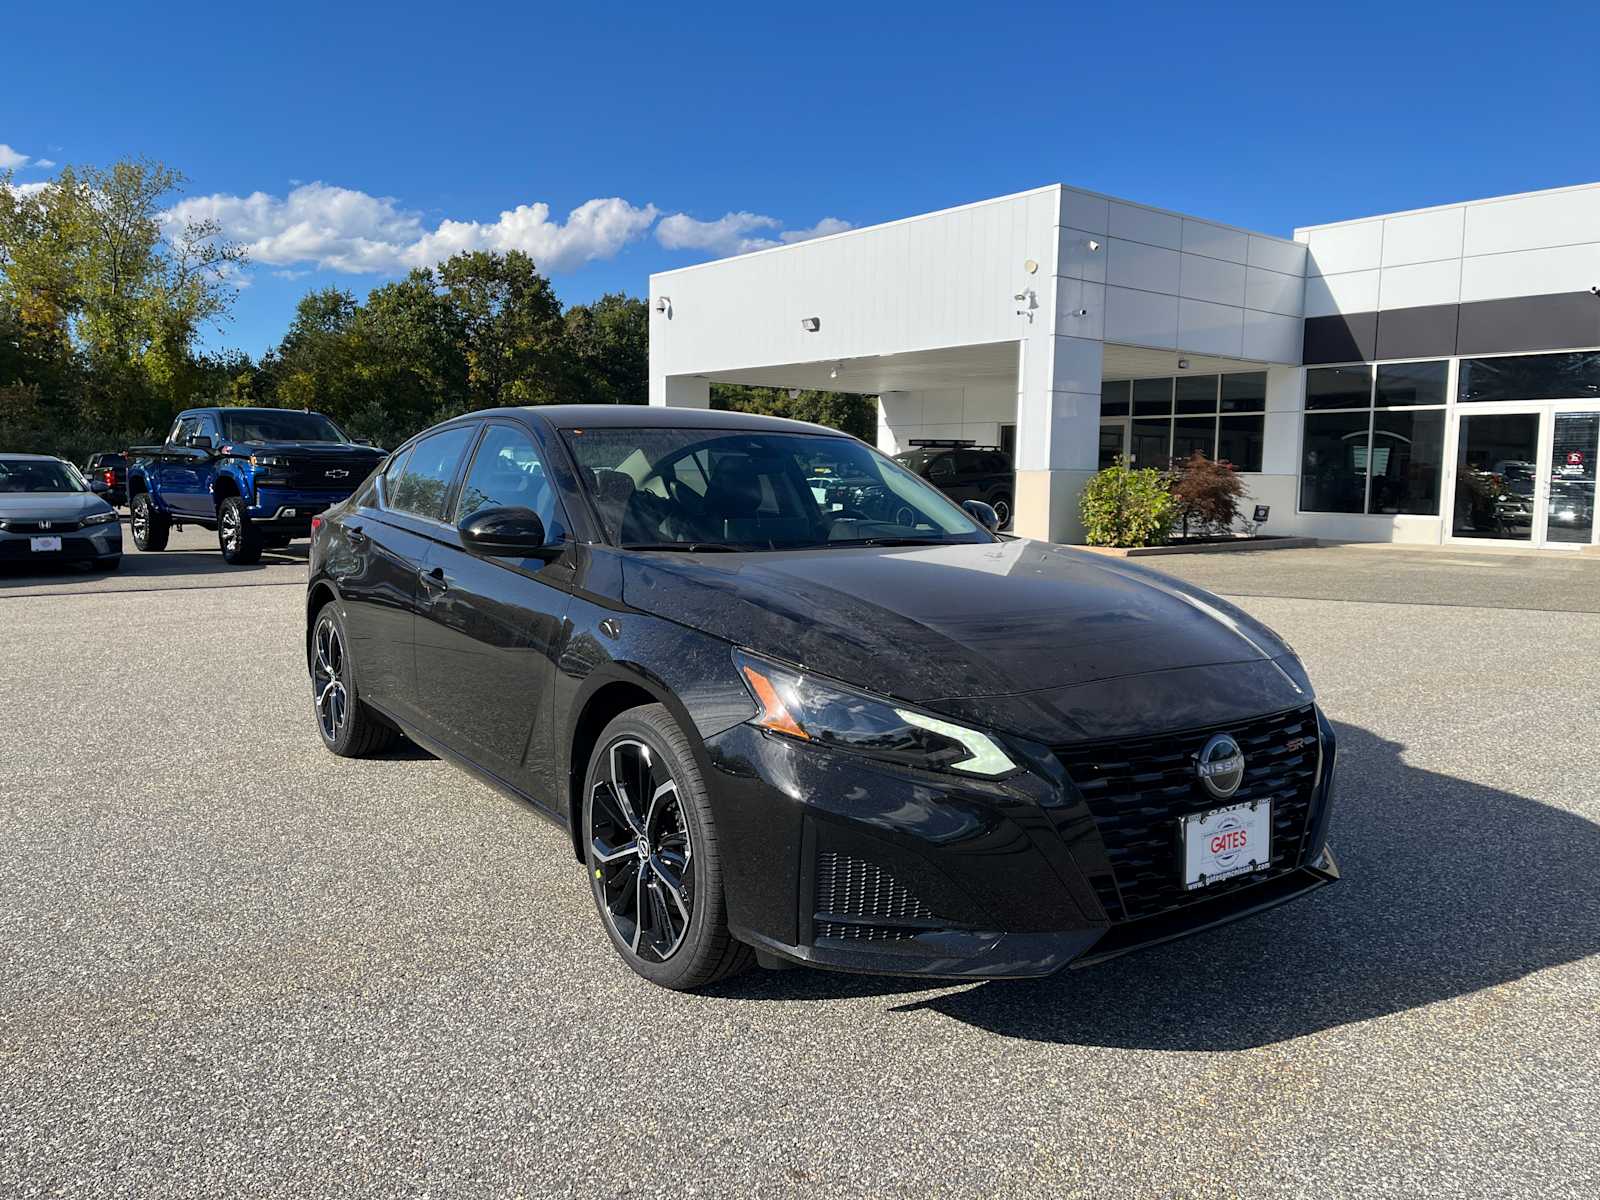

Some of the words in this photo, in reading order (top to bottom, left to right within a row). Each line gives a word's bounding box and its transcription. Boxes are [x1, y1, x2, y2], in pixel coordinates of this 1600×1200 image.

[1200, 757, 1242, 775] NISSAN
[1209, 801, 1252, 815] GATES
[1211, 831, 1247, 853] GATES
